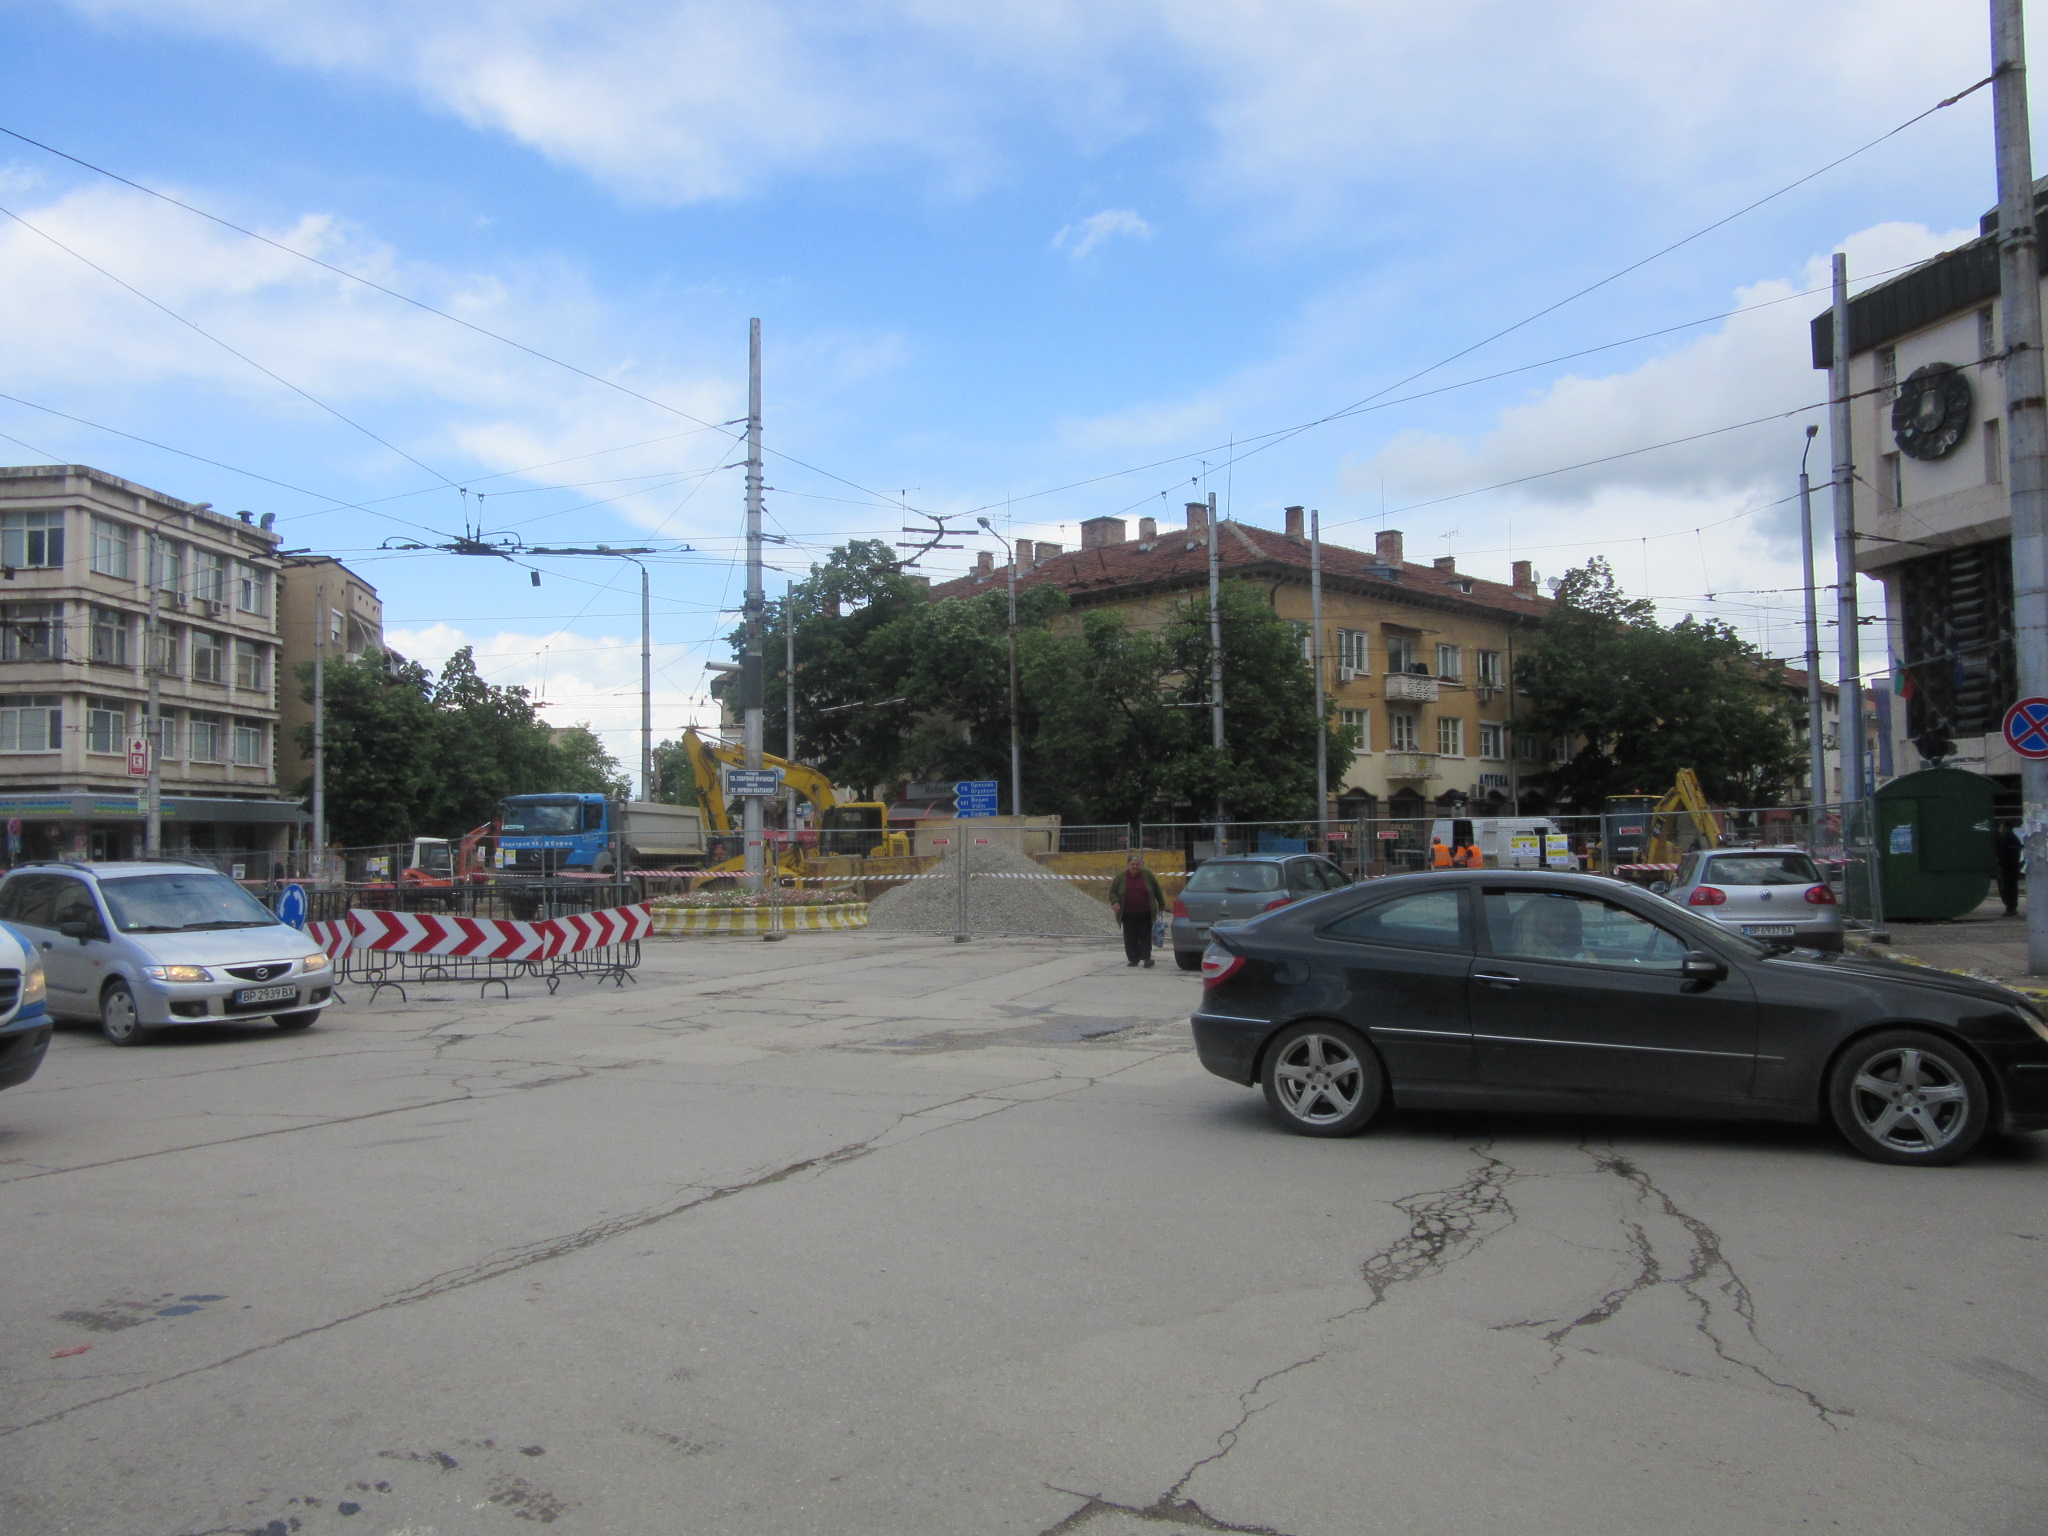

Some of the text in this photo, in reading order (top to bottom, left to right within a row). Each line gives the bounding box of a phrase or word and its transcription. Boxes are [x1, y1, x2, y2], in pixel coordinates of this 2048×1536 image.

[1479, 773, 1509, 787] АПТЕКА
[243, 986, 295, 1002] BP 2939 BX
